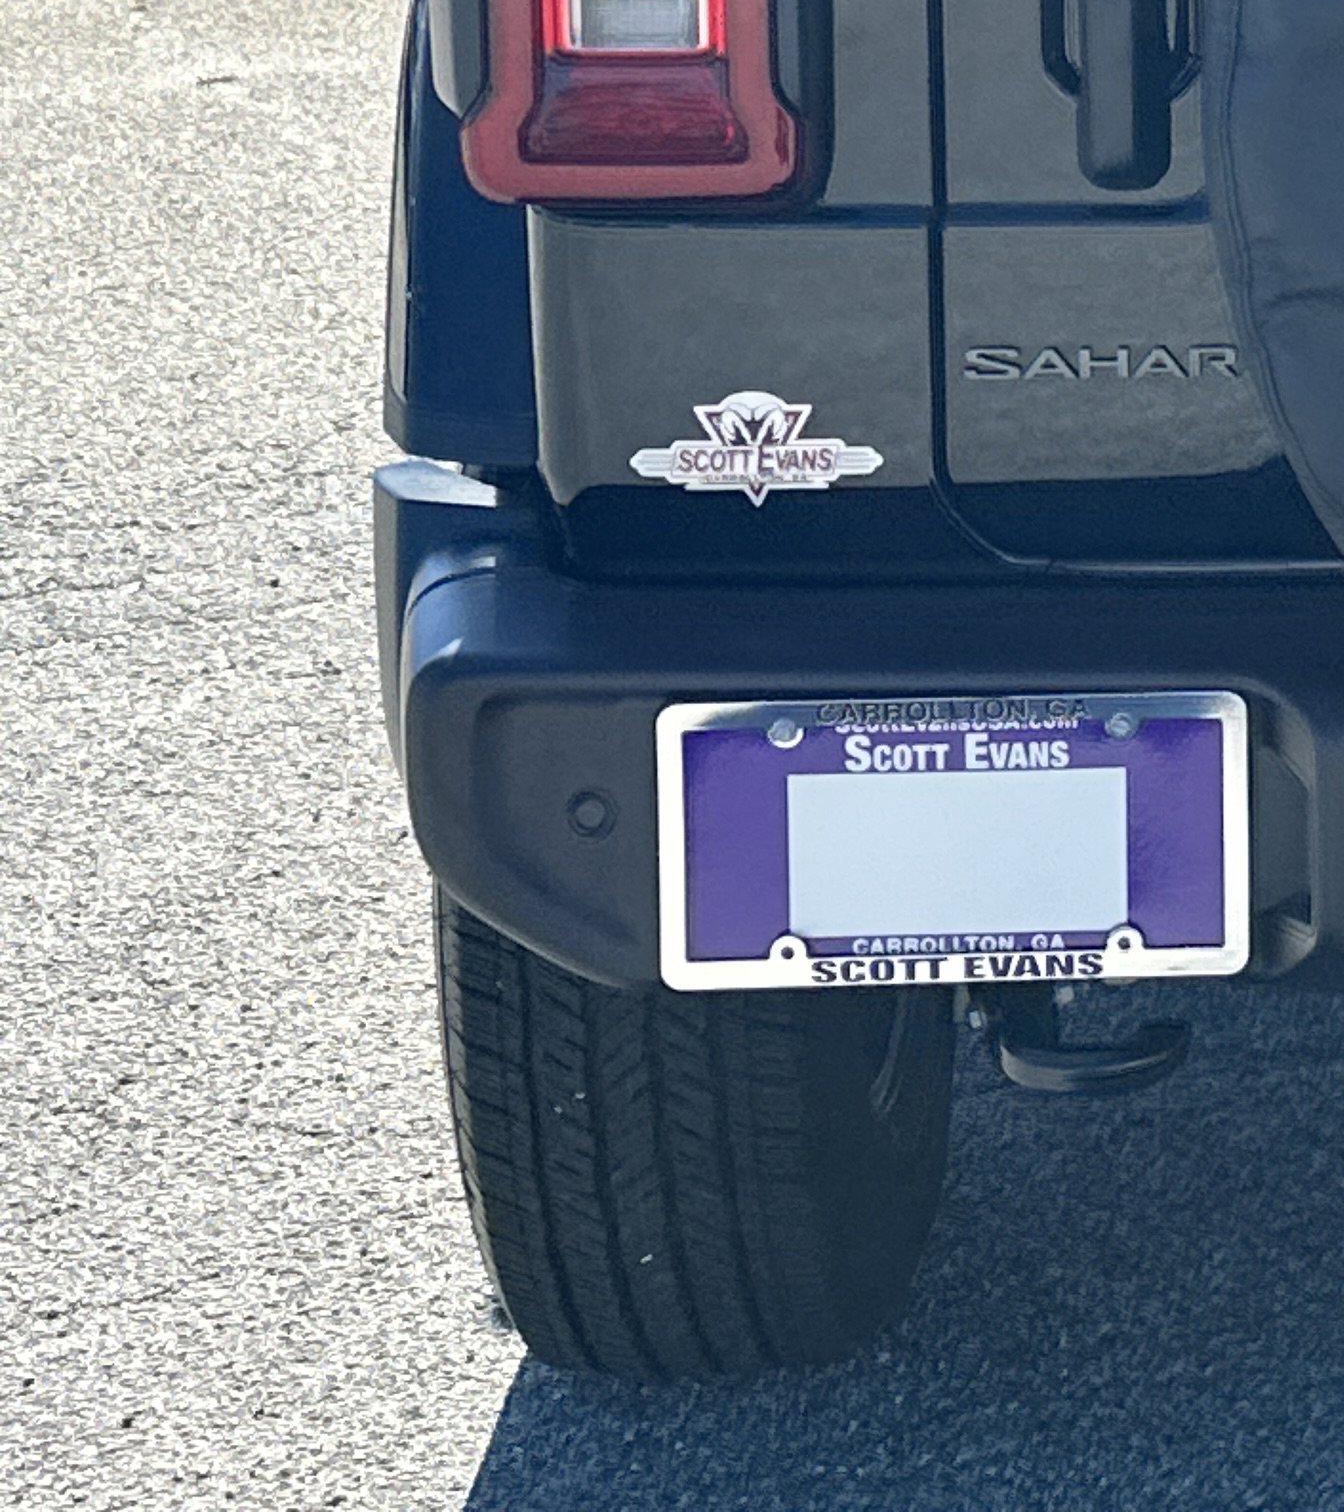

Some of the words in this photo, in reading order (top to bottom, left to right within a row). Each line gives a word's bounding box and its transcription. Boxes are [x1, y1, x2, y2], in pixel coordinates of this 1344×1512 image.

[964, 345, 1239, 380] SAHAR
[678, 449, 752, 474] SCOTT
[758, 445, 833, 474] EVANS
[844, 735, 949, 772] SCOTT
[964, 732, 1070, 769] EVANS
[811, 958, 947, 982] SCOTT
[963, 953, 1104, 978] EVANS
